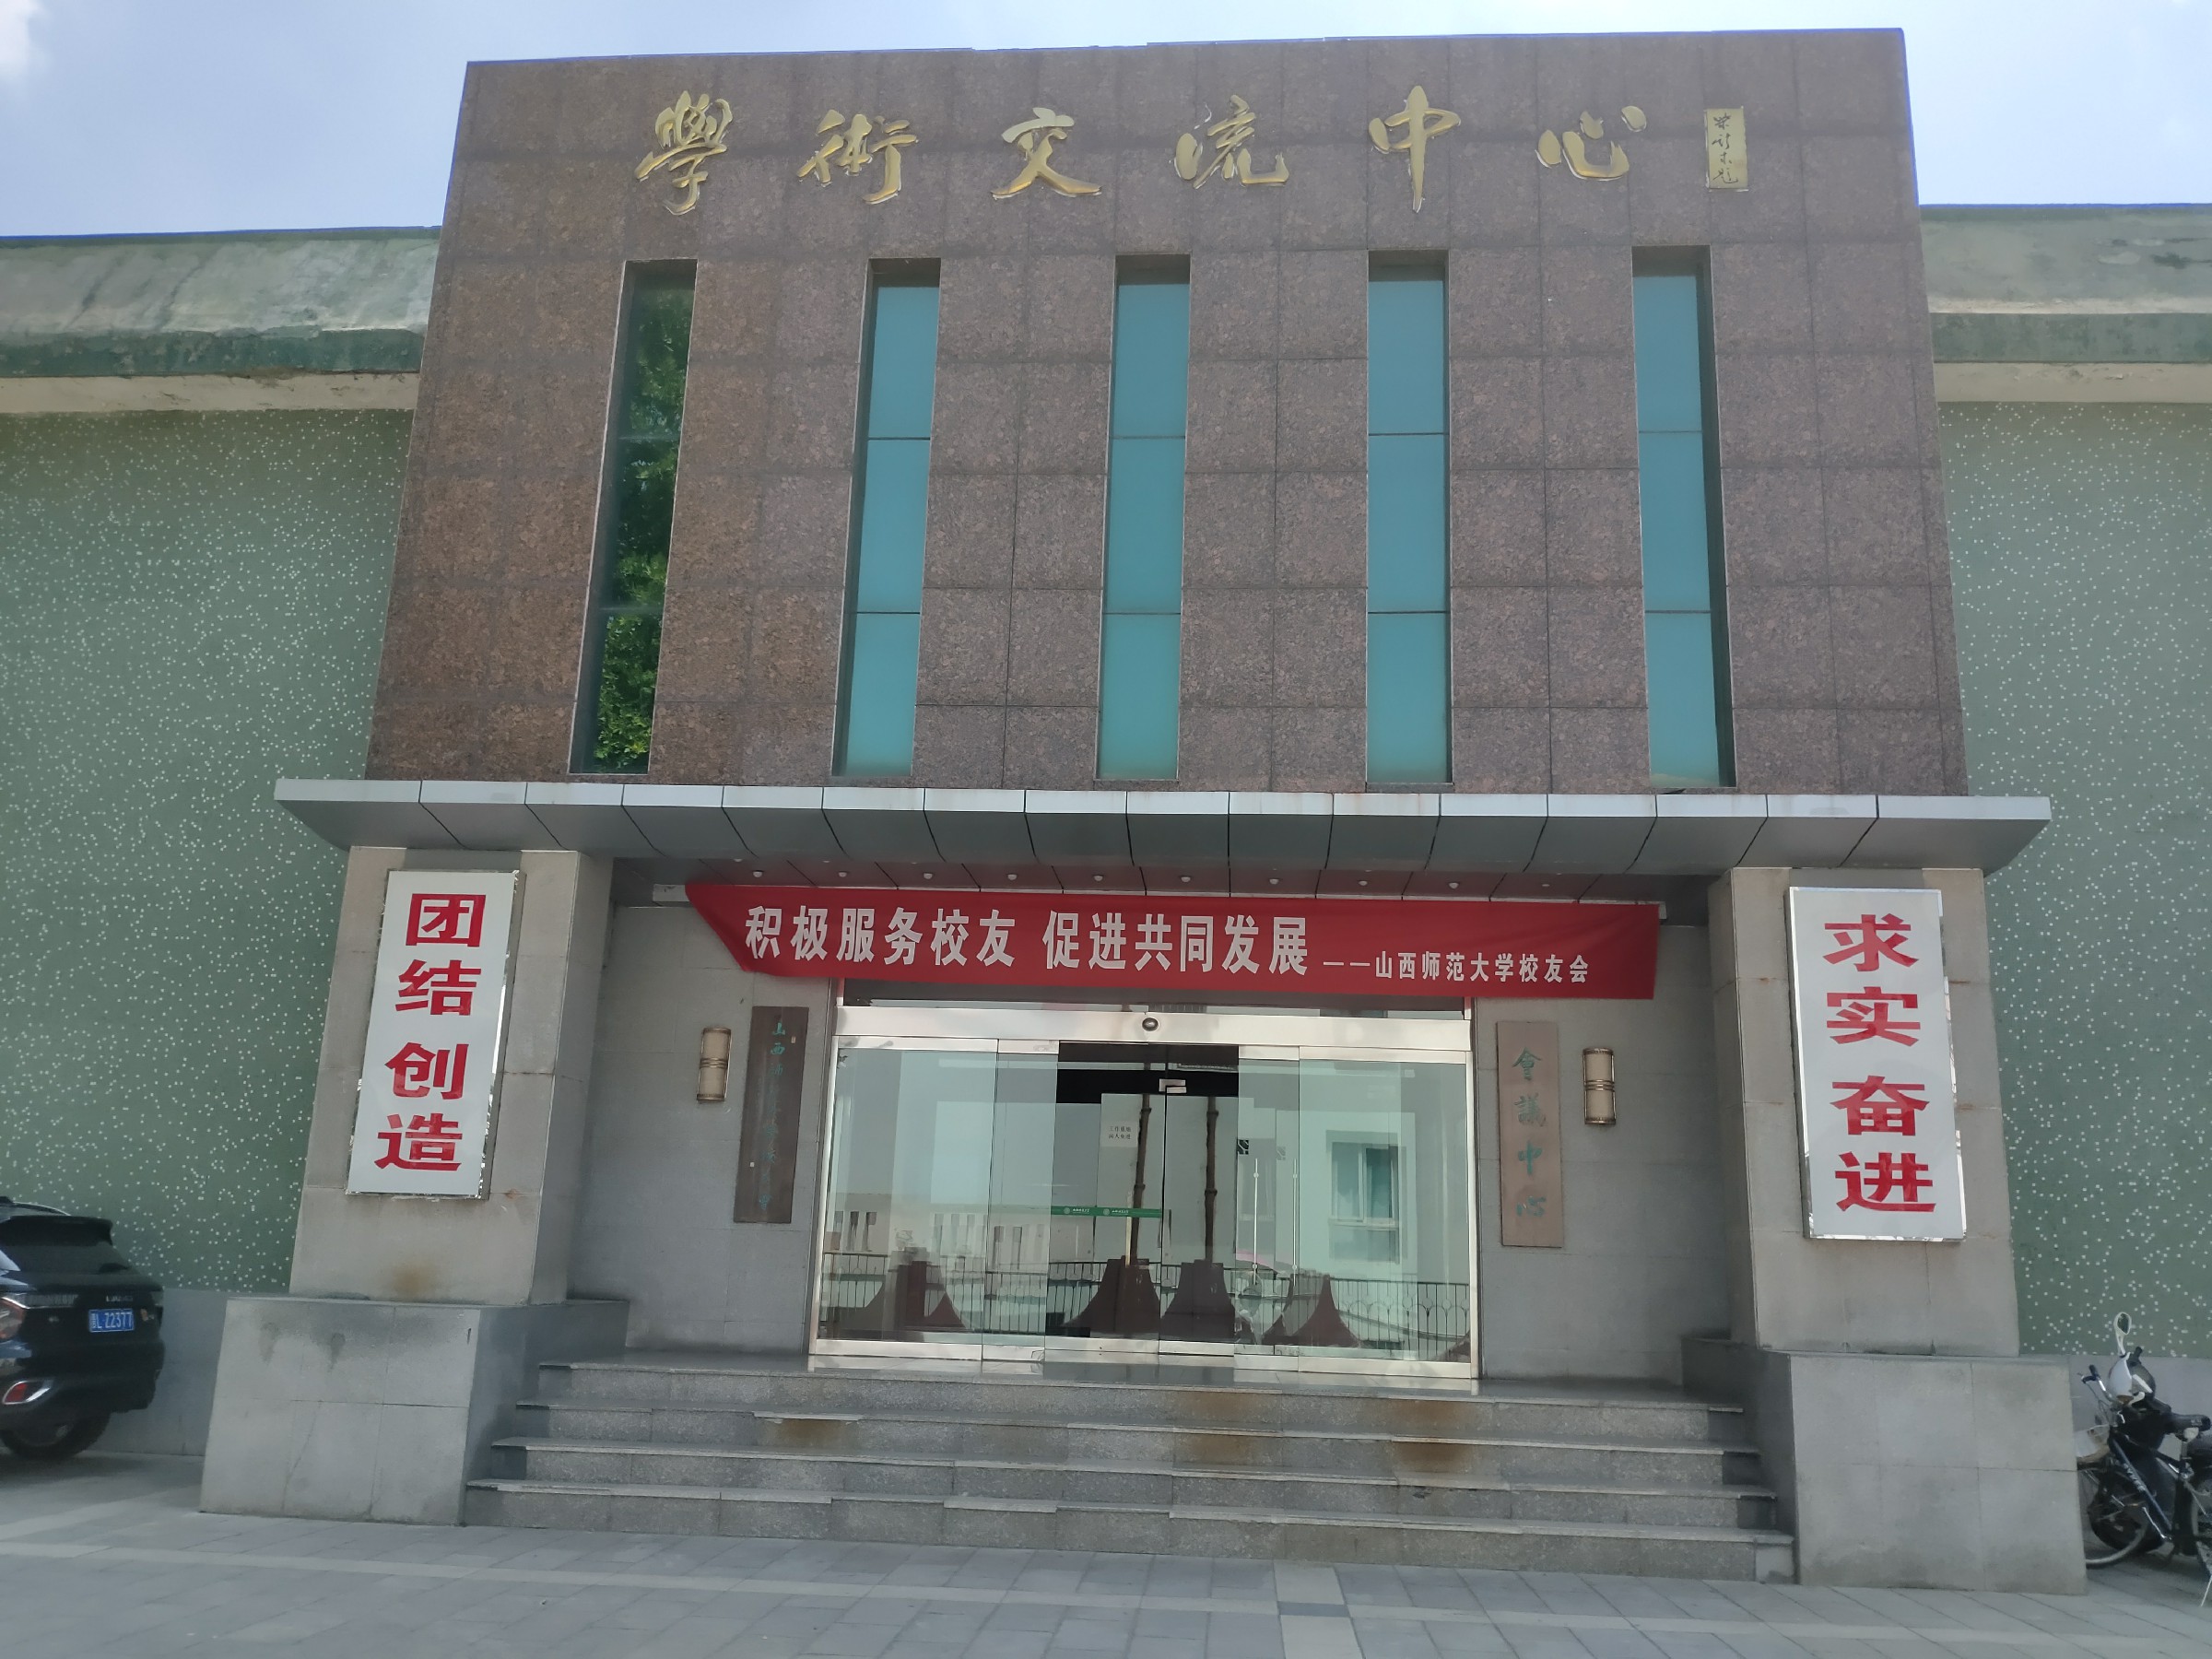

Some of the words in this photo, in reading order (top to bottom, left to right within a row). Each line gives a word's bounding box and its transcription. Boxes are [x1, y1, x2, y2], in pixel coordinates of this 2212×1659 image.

[374, 893, 487, 1171] 团结创造
[745, 905, 1016, 967] 积极服务校友
[1042, 910, 1309, 975] 促进共同发展
[1823, 912, 1936, 1213] 求实奋进
